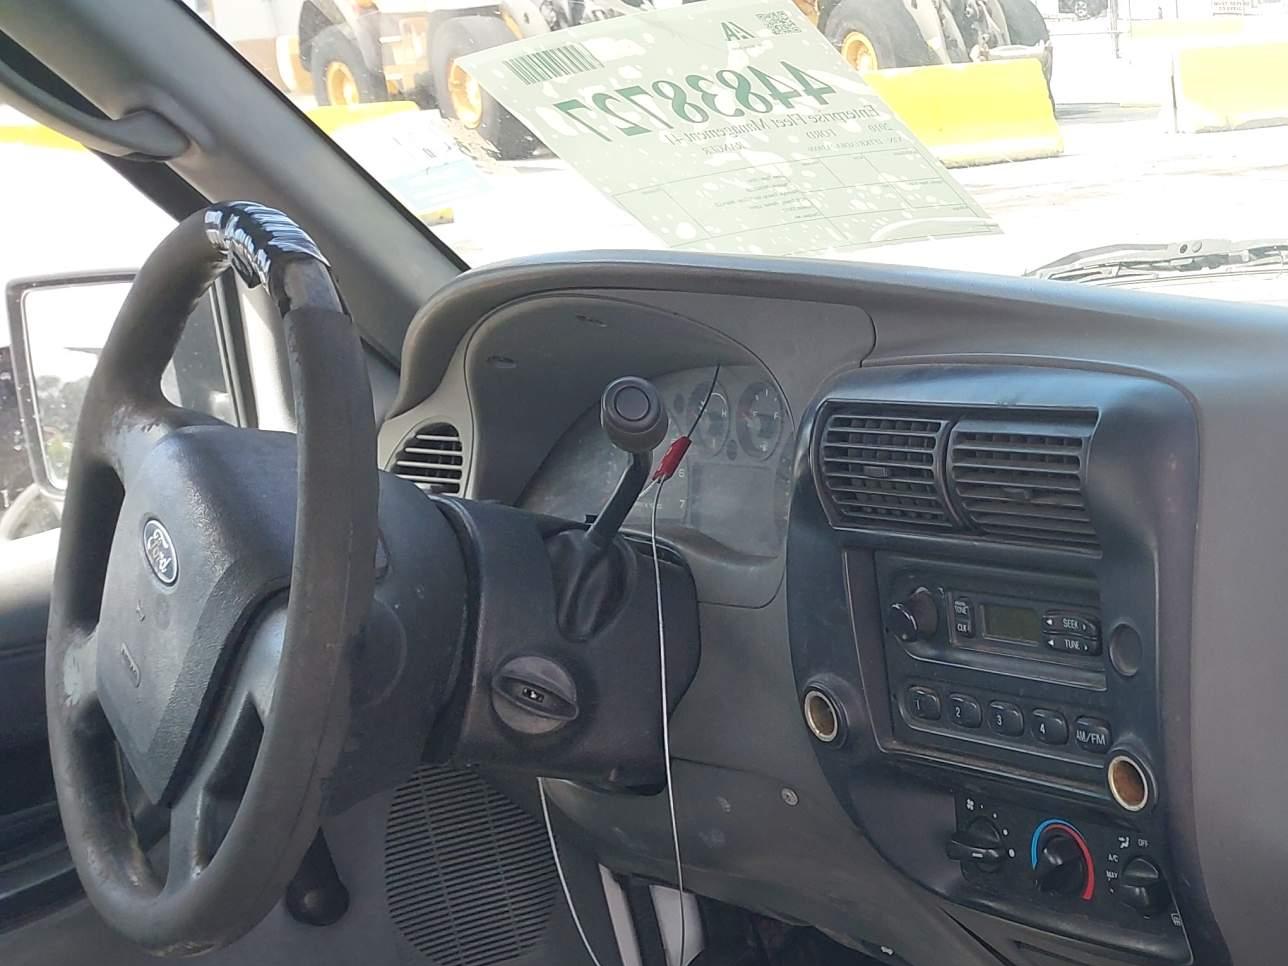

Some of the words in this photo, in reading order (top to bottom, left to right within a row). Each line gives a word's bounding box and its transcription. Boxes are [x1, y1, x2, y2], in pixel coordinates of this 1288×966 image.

[145, 526, 174, 576] Ford
[1062, 617, 1079, 630] SEEK
[1064, 639, 1081, 651] TUNE
[955, 707, 961, 719] 2
[996, 714, 1002, 726] 3
[1039, 723, 1046, 735] 4
[1076, 729, 1106, 746] AM/FM
